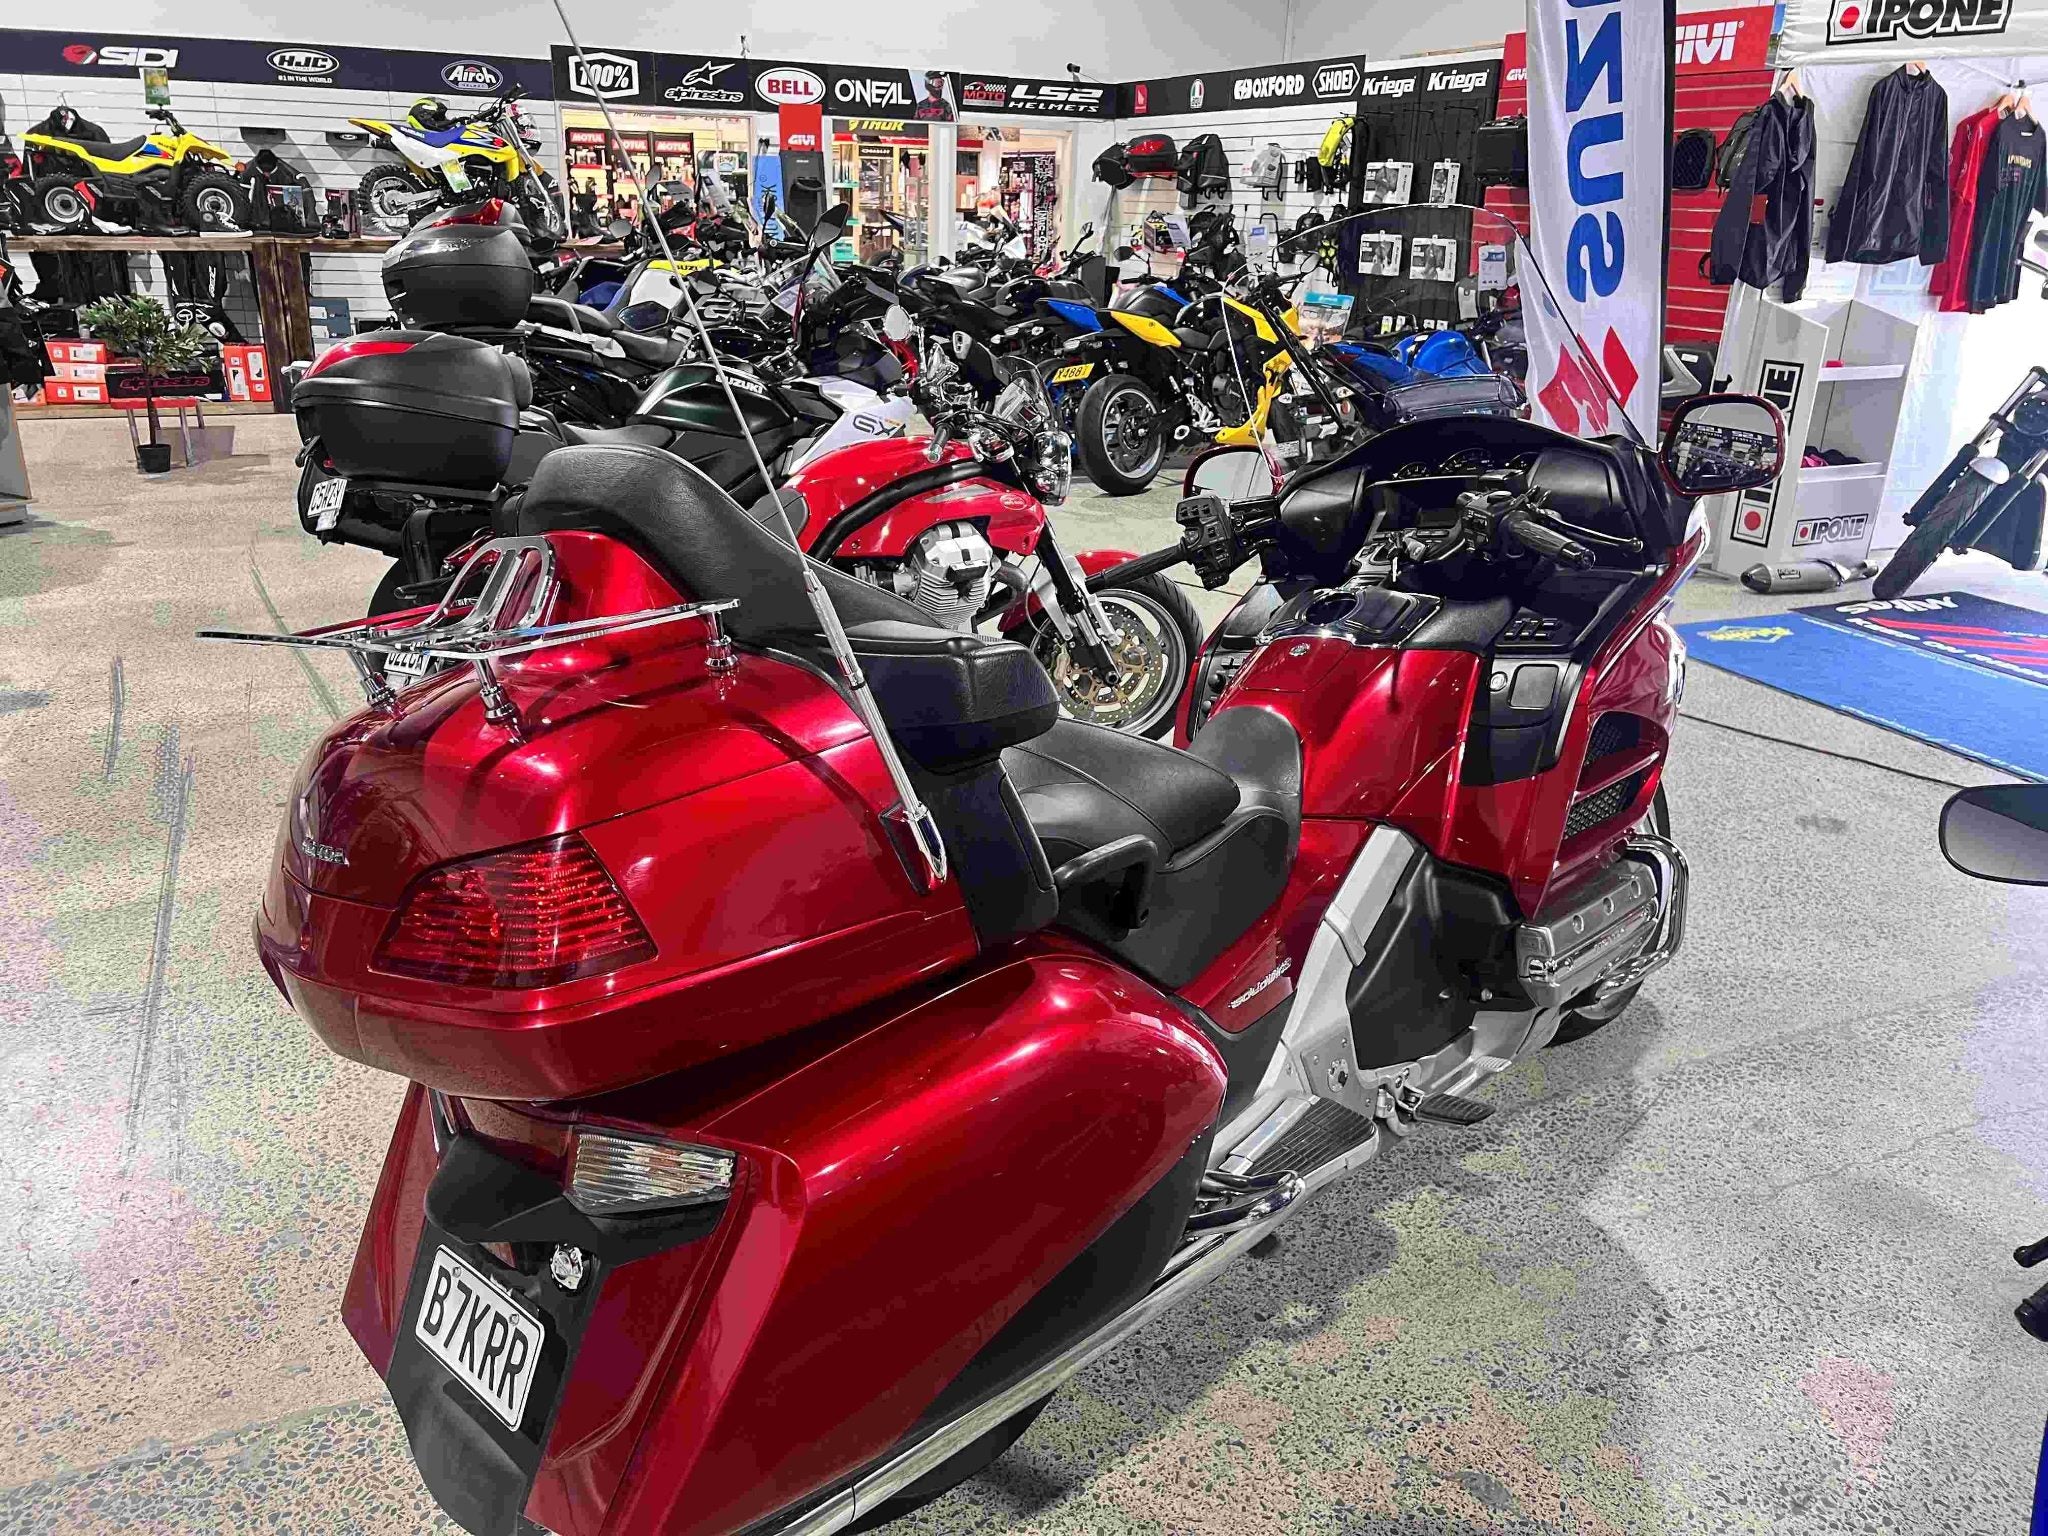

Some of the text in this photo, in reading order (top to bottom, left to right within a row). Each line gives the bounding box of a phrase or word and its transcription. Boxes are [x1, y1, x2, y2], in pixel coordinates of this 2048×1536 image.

[1866, 0, 2003, 34] IPONE
[1676, 20, 1738, 65] IVI
[97, 46, 179, 68] SIDI
[278, 54, 328, 69] HJC
[308, 76, 333, 84] WORLD
[448, 65, 497, 84] Airoh
[579, 63, 630, 88] 100%
[1318, 73, 1353, 92] SHOEI
[1427, 70, 1488, 92] Kriega
[664, 87, 744, 102] alpinestars
[767, 78, 814, 96] BELL
[963, 90, 1006, 101] MOTO
[1010, 85, 1104, 104] LS2
[1252, 74, 1305, 98] OXFORD
[1362, 76, 1415, 98] Kriega
[1008, 101, 1100, 113] HELMETS
[571, 132, 603, 143] MOTUL
[657, 142, 689, 151] MOTUL
[787, 133, 816, 146] GIVI
[1811, 517, 1865, 541] IPONE
[423, 1266, 528, 1410] B7KRR
